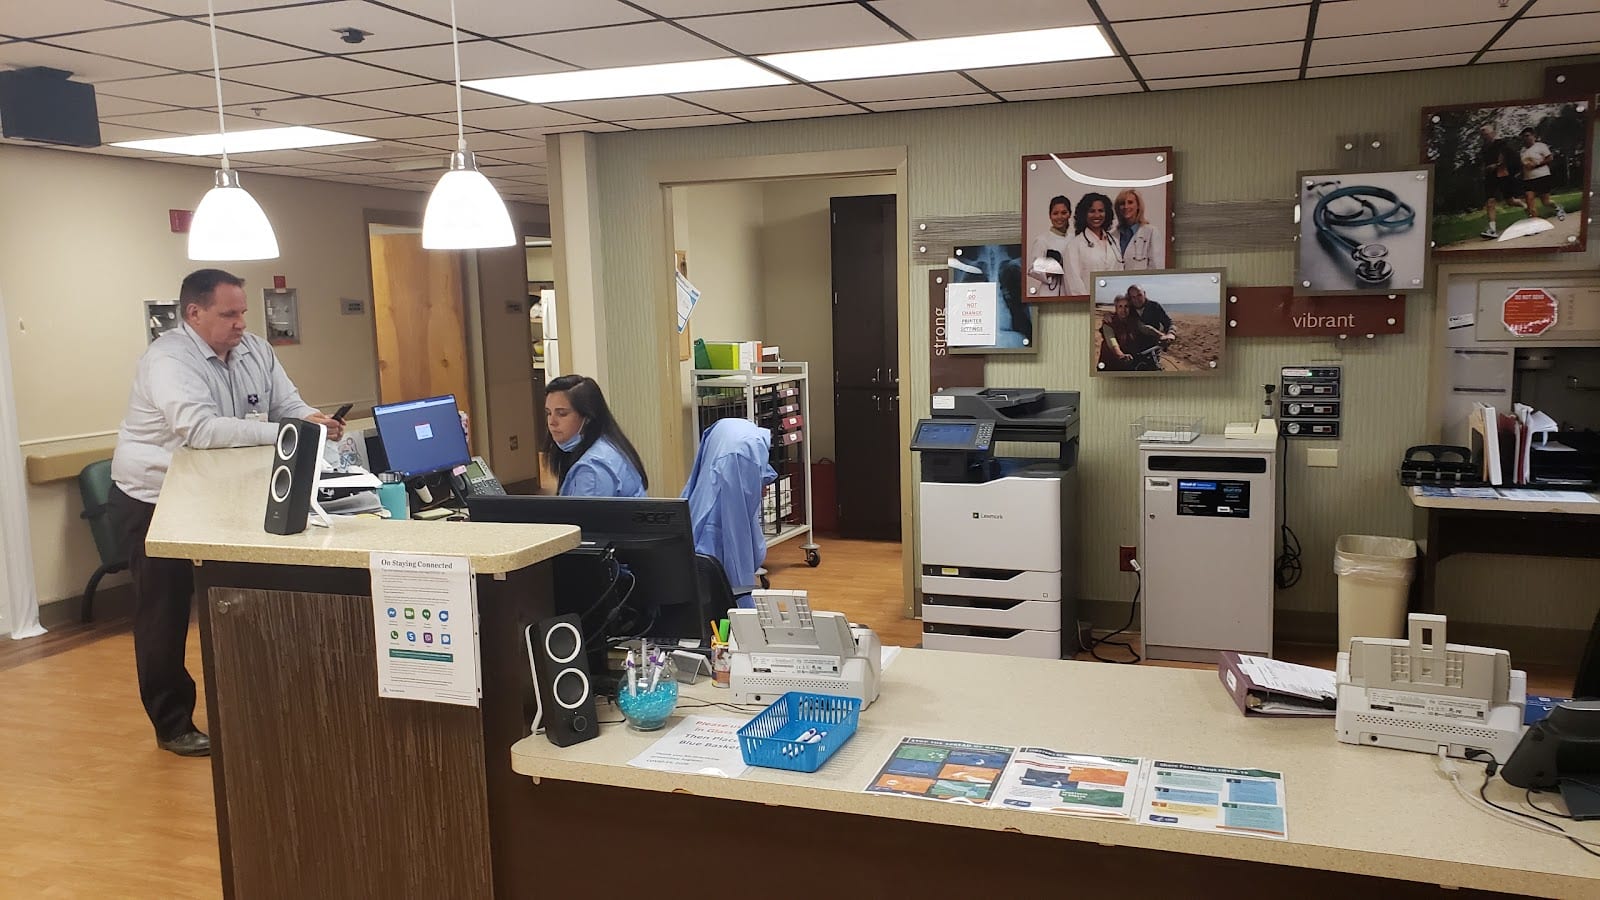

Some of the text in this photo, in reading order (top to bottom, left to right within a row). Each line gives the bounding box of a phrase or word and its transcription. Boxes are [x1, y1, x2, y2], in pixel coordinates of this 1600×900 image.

[1292, 312, 1356, 328] vibrant
[933, 307, 946, 356] strong
[392, 560, 417, 568] Staying
[417, 561, 453, 569] Connected
